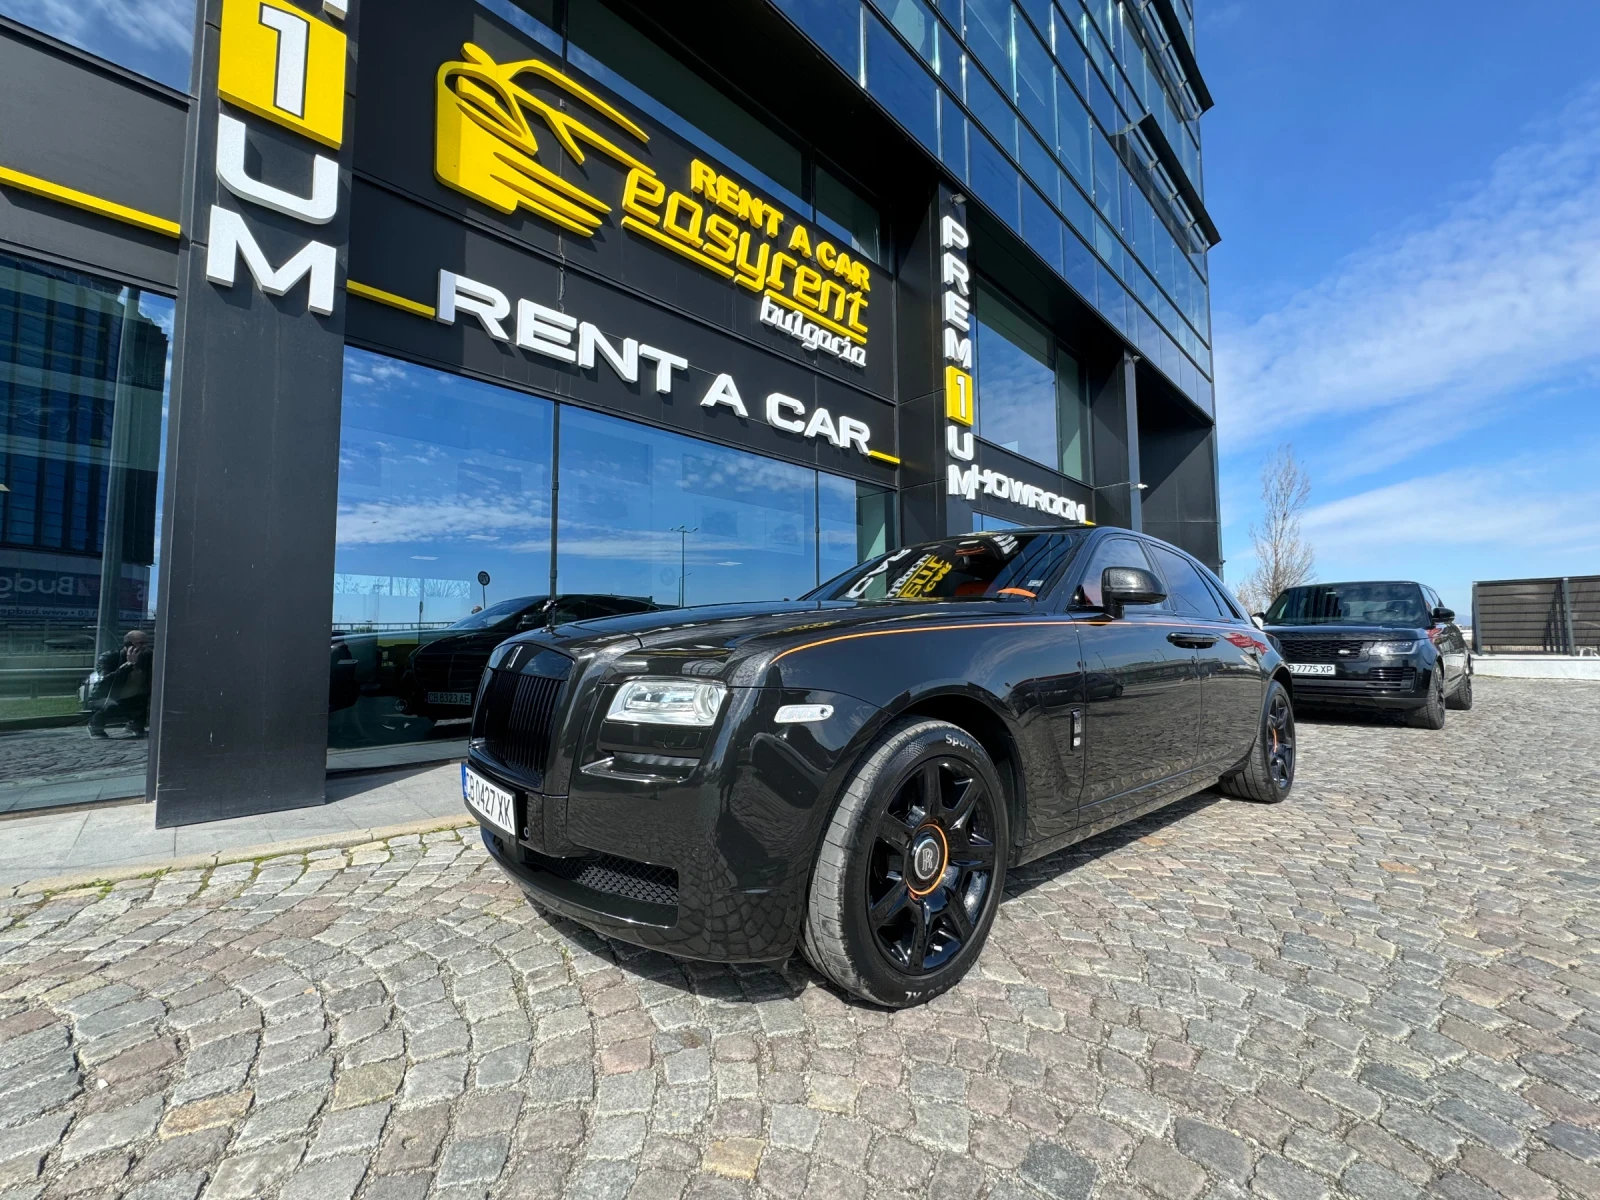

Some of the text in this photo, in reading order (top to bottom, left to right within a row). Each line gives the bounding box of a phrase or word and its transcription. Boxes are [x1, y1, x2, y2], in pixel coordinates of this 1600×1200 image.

[622, 167, 868, 334] easyrent
[691, 158, 871, 293] RENT A CAR
[438, 269, 871, 453] RENT A CAR
[760, 295, 867, 368] bulgaria
[970, 464, 1086, 523] HOWROOM
[428, 692, 470, 705] CB 8323 AE
[475, 779, 496, 817] 0427
[497, 792, 513, 831] XK
